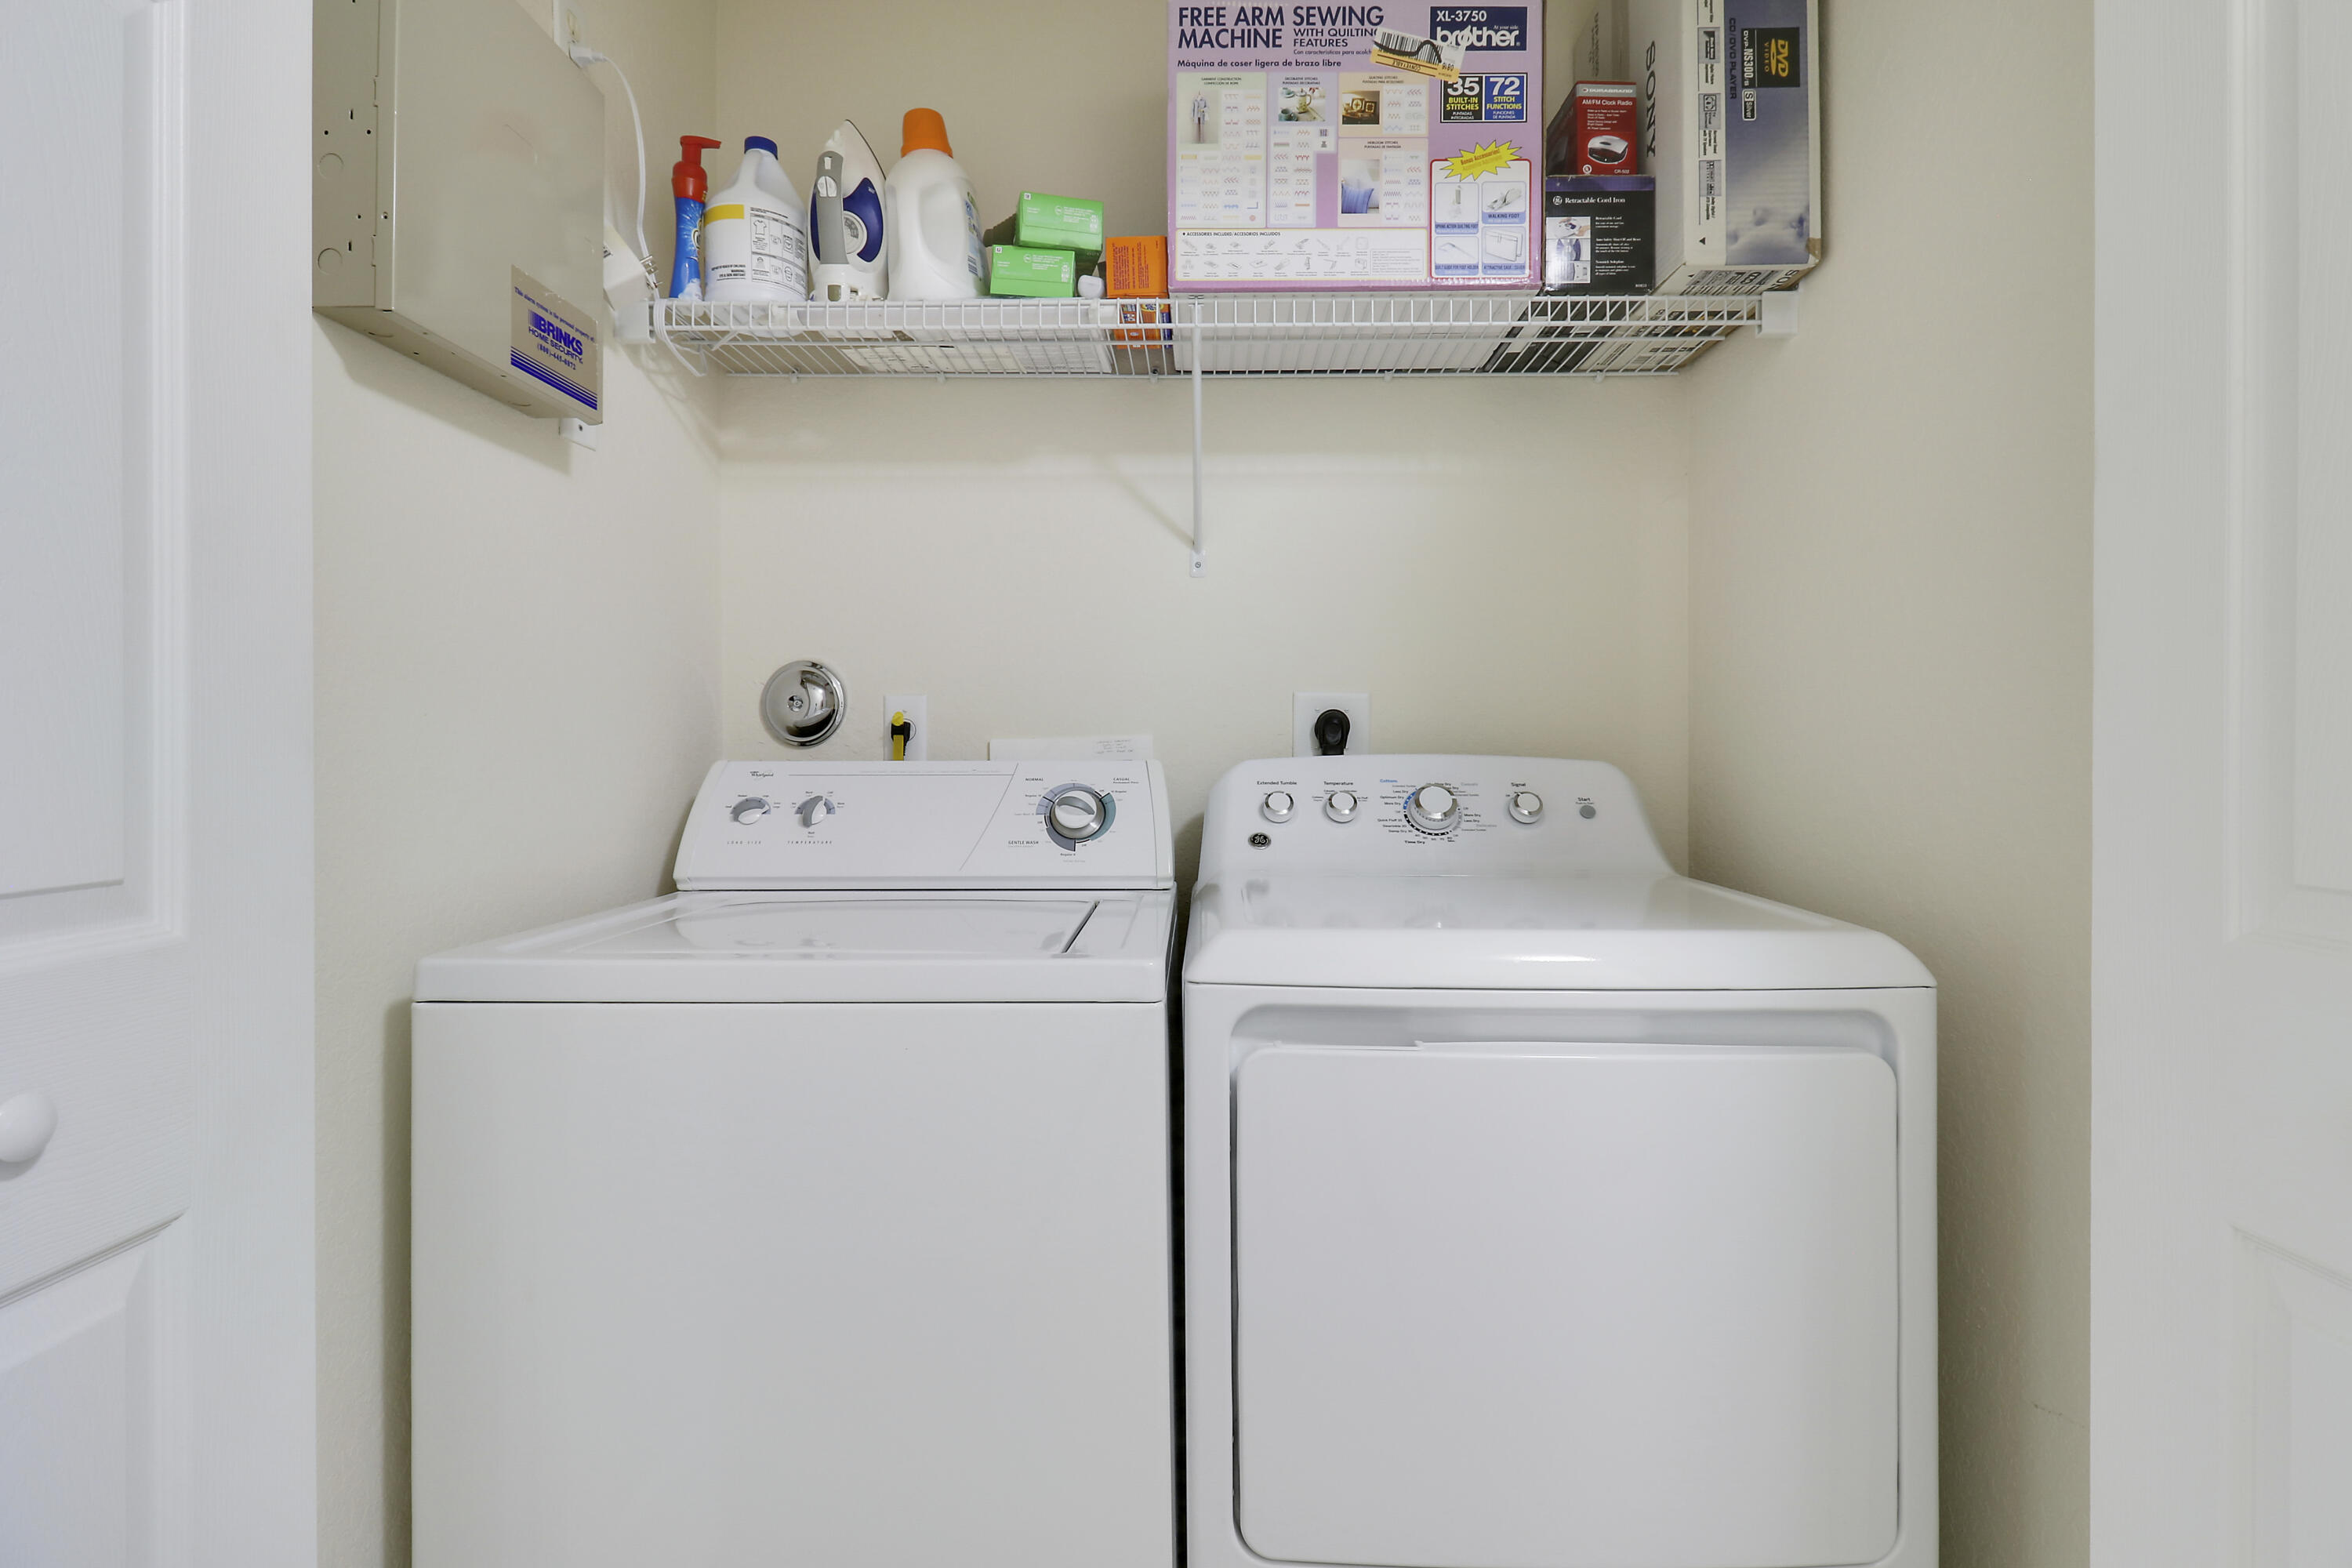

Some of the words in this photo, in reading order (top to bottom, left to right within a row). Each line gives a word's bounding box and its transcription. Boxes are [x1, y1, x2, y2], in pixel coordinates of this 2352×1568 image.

[1178, 6, 1226, 27] FREE
[1233, 6, 1285, 26] ARM
[1293, 5, 1385, 27] SEWING
[1436, 10, 1486, 22] XL-3750
[1178, 28, 1283, 49] MACHINE
[1294, 28, 1324, 37] WITH
[1436, 25, 1519, 47] brother
[1177, 60, 1215, 69] Máquina
[1254, 59, 1279, 69] ligera
[1295, 58, 1319, 67] brazo
[1322, 58, 1342, 67] libre
[1777, 39, 1789, 77] DVD
[1447, 77, 1480, 96] 35
[1490, 76, 1520, 96] 72
[1646, 40, 1656, 157] SONY
[528, 326, 549, 344] HOME
[533, 312, 583, 356] BRINKS
